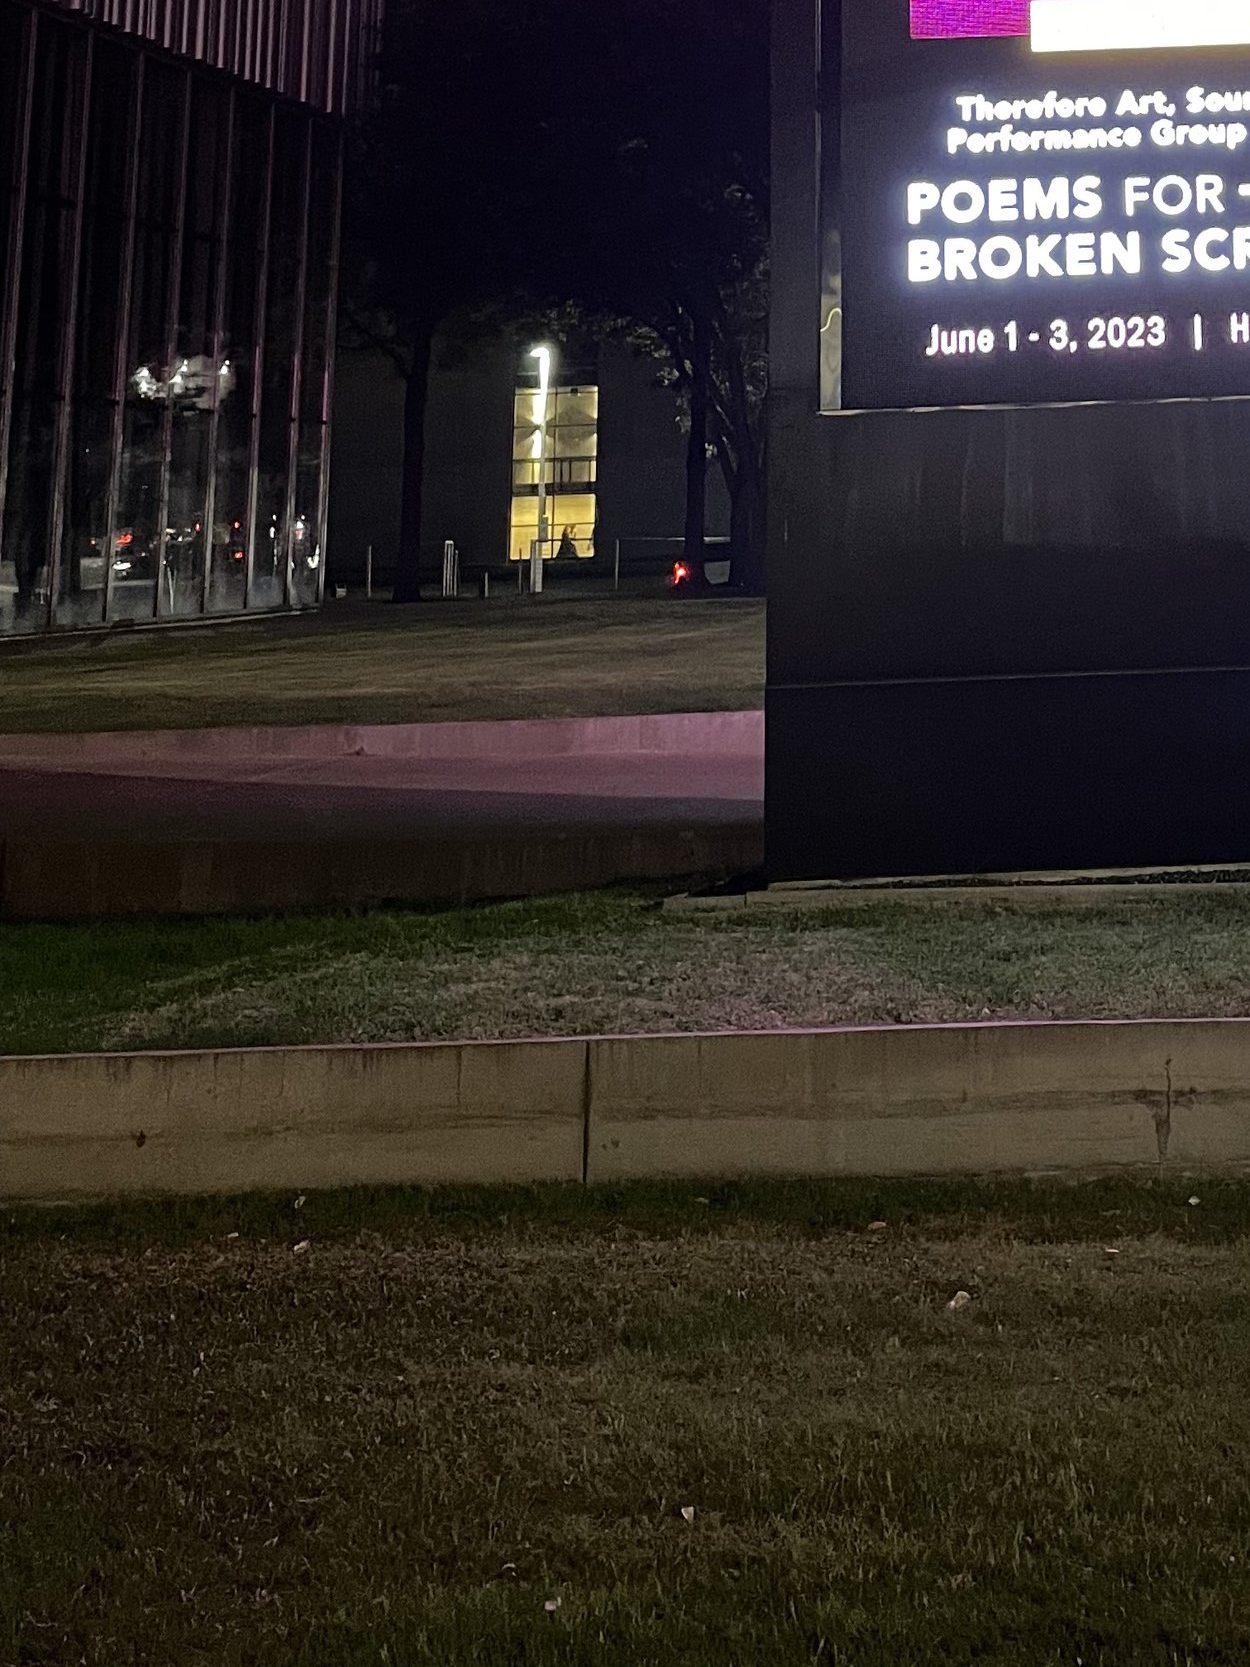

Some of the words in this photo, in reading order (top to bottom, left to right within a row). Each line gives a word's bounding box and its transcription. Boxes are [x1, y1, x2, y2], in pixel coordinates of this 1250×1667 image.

[955, 90, 1107, 122] Therefore
[1114, 89, 1177, 117] Art,
[946, 123, 1143, 155] Performance
[1150, 118, 1248, 151] Group
[907, 174, 1103, 225] POEMS
[1124, 174, 1226, 217] FOR
[907, 228, 1142, 283] BROKEN
[925, 323, 995, 356] June
[1003, 320, 1017, 352] 1
[1049, 318, 1078, 353] 3,
[1087, 315, 1166, 349] 2023
